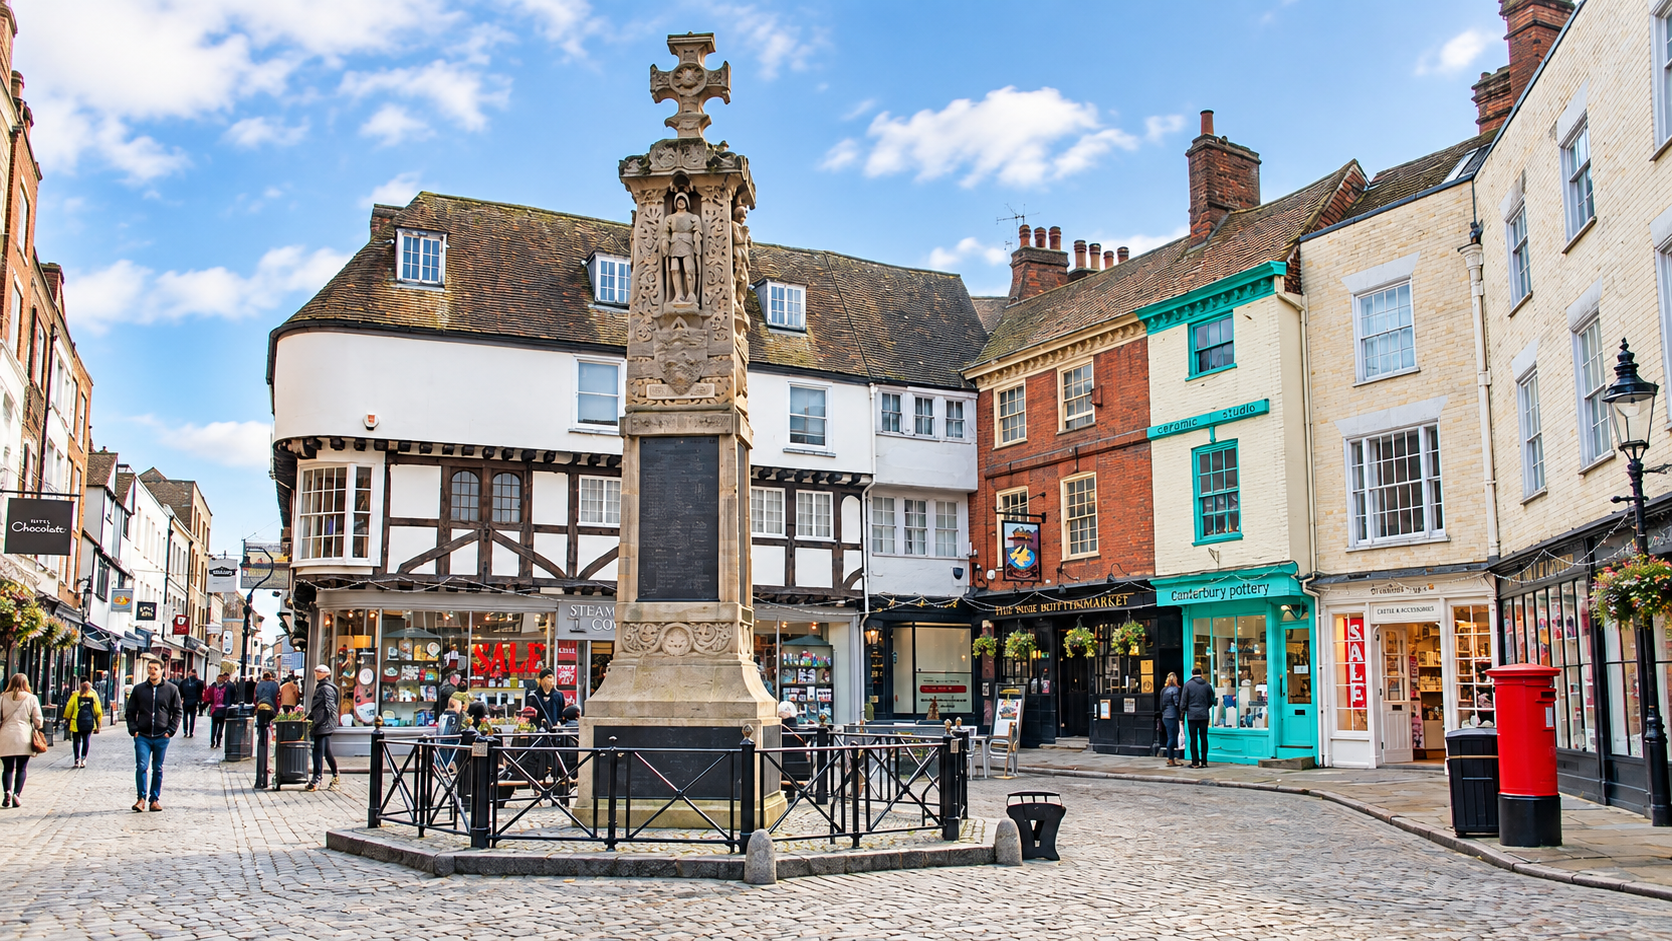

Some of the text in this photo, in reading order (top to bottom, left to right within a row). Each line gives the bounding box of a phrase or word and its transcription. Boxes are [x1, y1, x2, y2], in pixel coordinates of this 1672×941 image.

[1157, 418, 1198, 434] ceramic
[1171, 583, 1270, 601] Canterbury pottery
[472, 641, 546, 676] SALE
[1349, 624, 1364, 702] SALE
